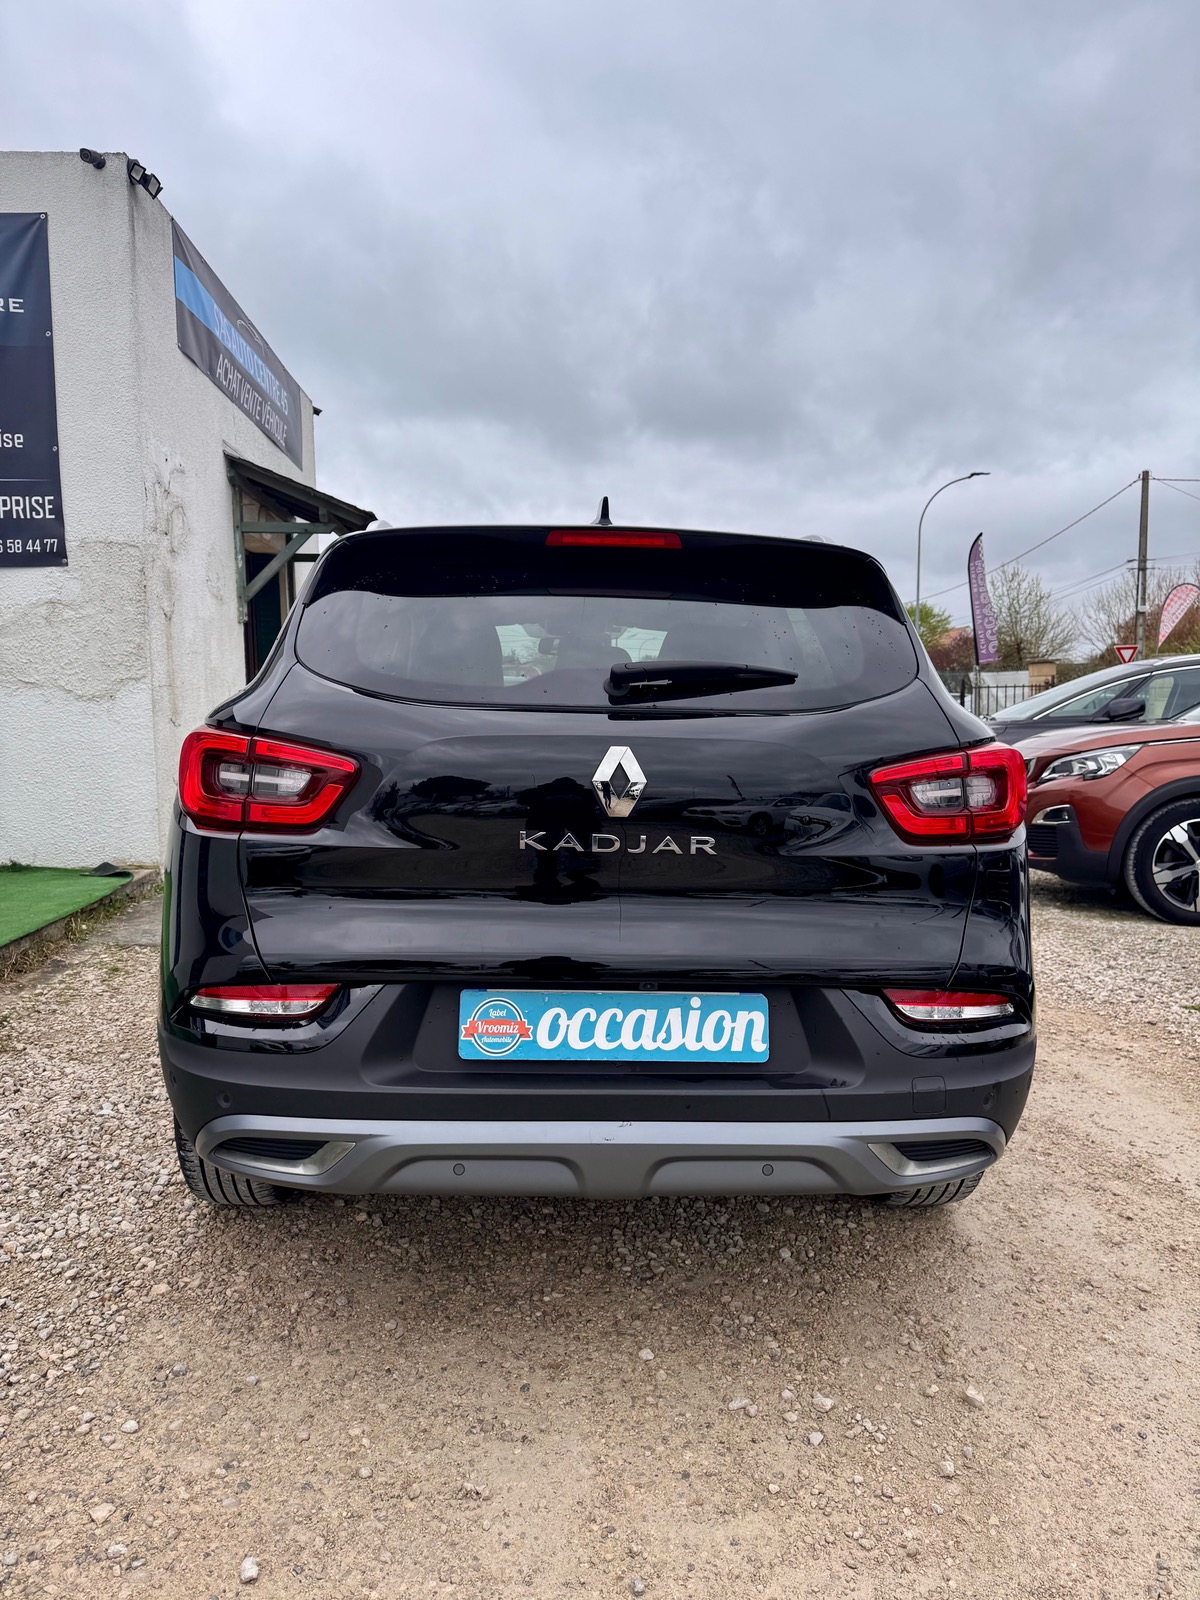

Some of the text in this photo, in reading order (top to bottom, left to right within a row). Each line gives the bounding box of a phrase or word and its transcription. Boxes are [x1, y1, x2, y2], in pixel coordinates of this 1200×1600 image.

[213, 303, 288, 416] SAS AUTO CENTRE 45
[216, 353, 288, 447] ACHAT VENTE VÉHICULE
[0, 495, 56, 519] PRISE
[6, 539, 23, 553] 58
[25, 539, 41, 553] 44
[43, 538, 58, 553] 77
[978, 631, 987, 654] ACHAT
[519, 830, 718, 855] KADJAR
[488, 1008, 507, 1018] Label
[536, 996, 768, 1053] occasion
[475, 1021, 519, 1034] Vroomiz
